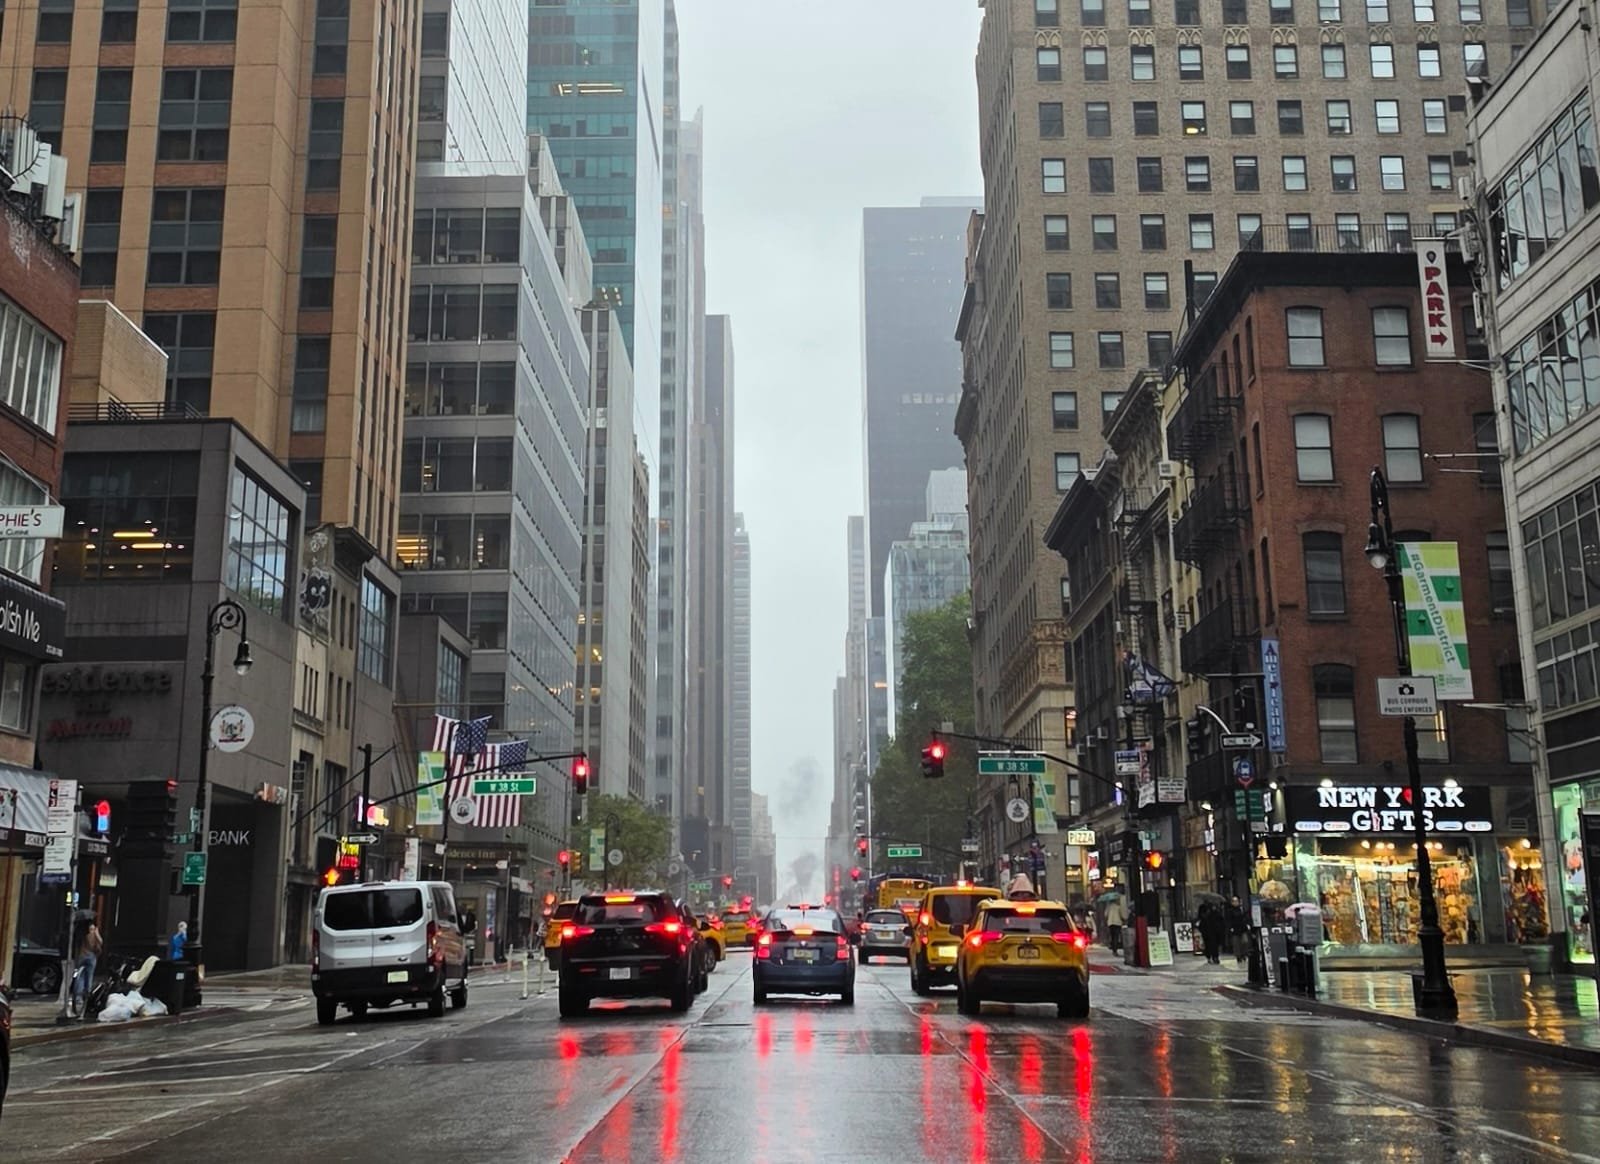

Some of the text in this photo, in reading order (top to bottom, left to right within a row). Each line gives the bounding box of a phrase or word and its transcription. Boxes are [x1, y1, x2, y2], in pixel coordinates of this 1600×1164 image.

[1424, 266, 1448, 327] PARK
[1410, 553, 1457, 663] #GarmentDistrict
[22, 609, 41, 643] Me
[1387, 697, 1399, 705] BUS
[997, 762, 1004, 770] W
[1006, 762, 1017, 770] 38
[489, 783, 496, 791] W
[499, 783, 508, 792] 38
[1317, 787, 1377, 808] NEW
[208, 830, 250, 846] BANK
[1069, 832, 1094, 843] PIZZA
